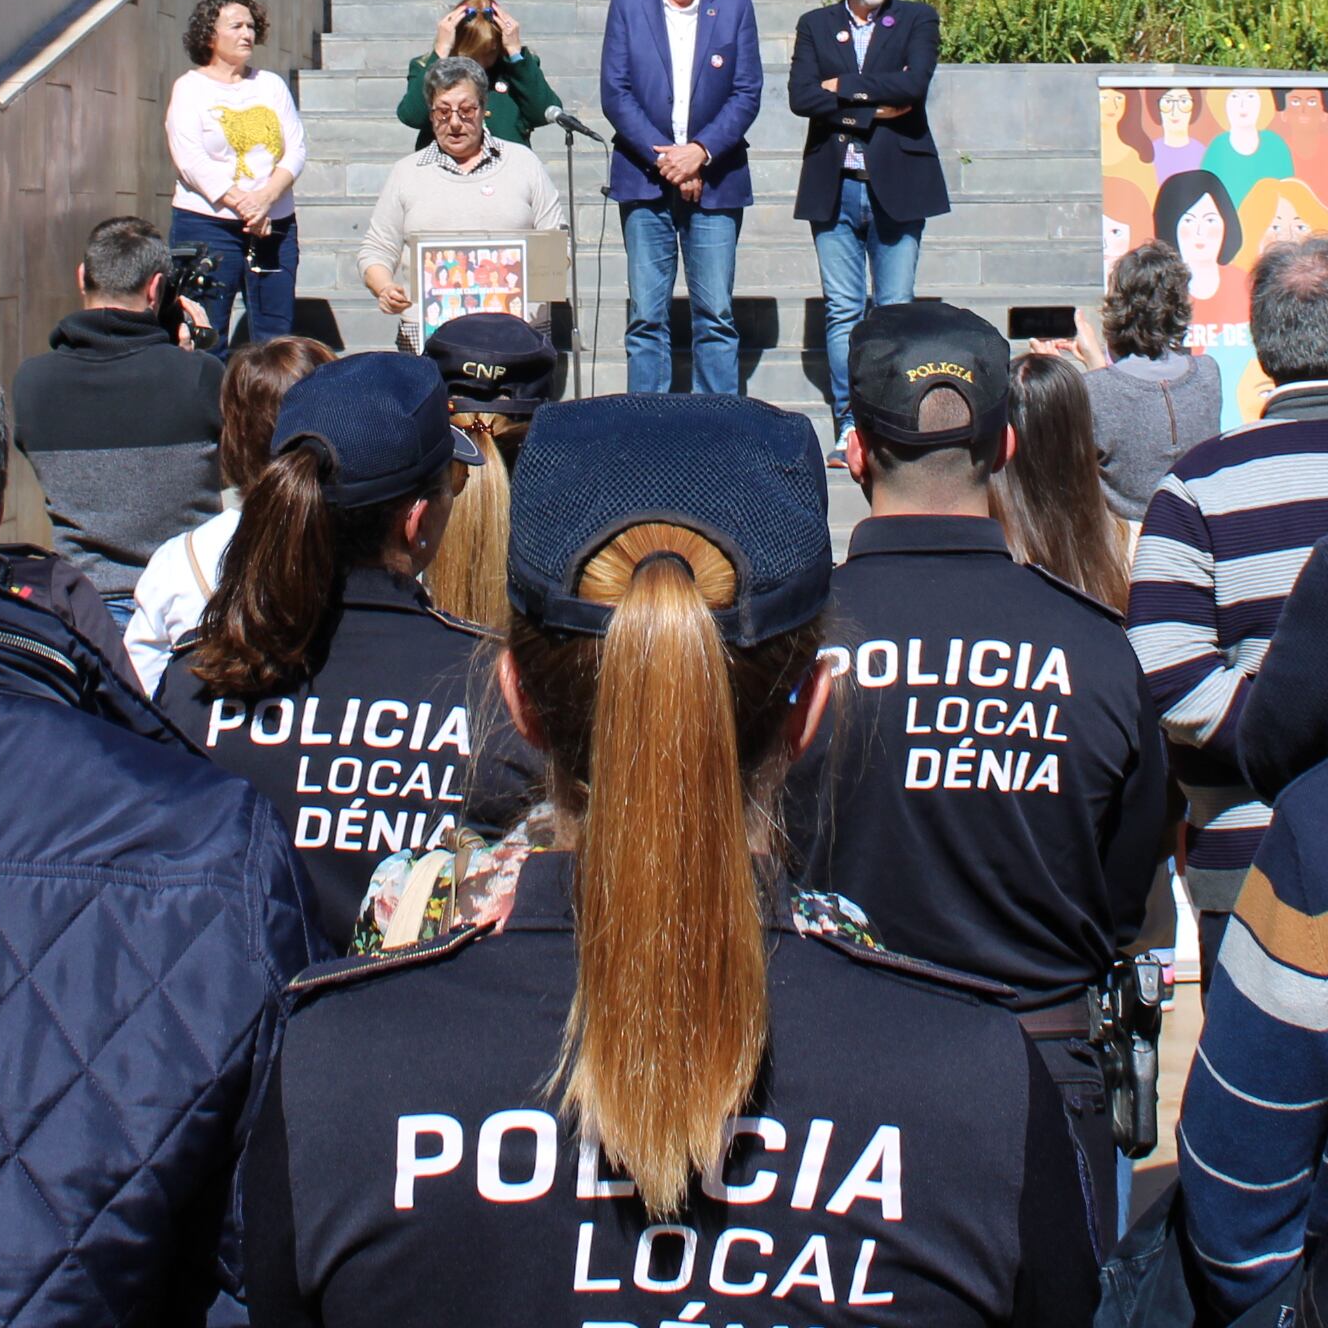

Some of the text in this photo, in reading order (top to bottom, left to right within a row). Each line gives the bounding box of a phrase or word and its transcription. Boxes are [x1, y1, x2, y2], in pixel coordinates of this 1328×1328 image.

[906, 361, 974, 383] POLICIA
[206, 696, 471, 756] POLICIA
[905, 696, 1068, 742] LOCAL
[296, 755, 464, 802] LOCAL
[904, 737, 1059, 793] DÉNIA
[394, 1108, 903, 1220] POLCIA
[573, 1222, 894, 1305] LOCAL
